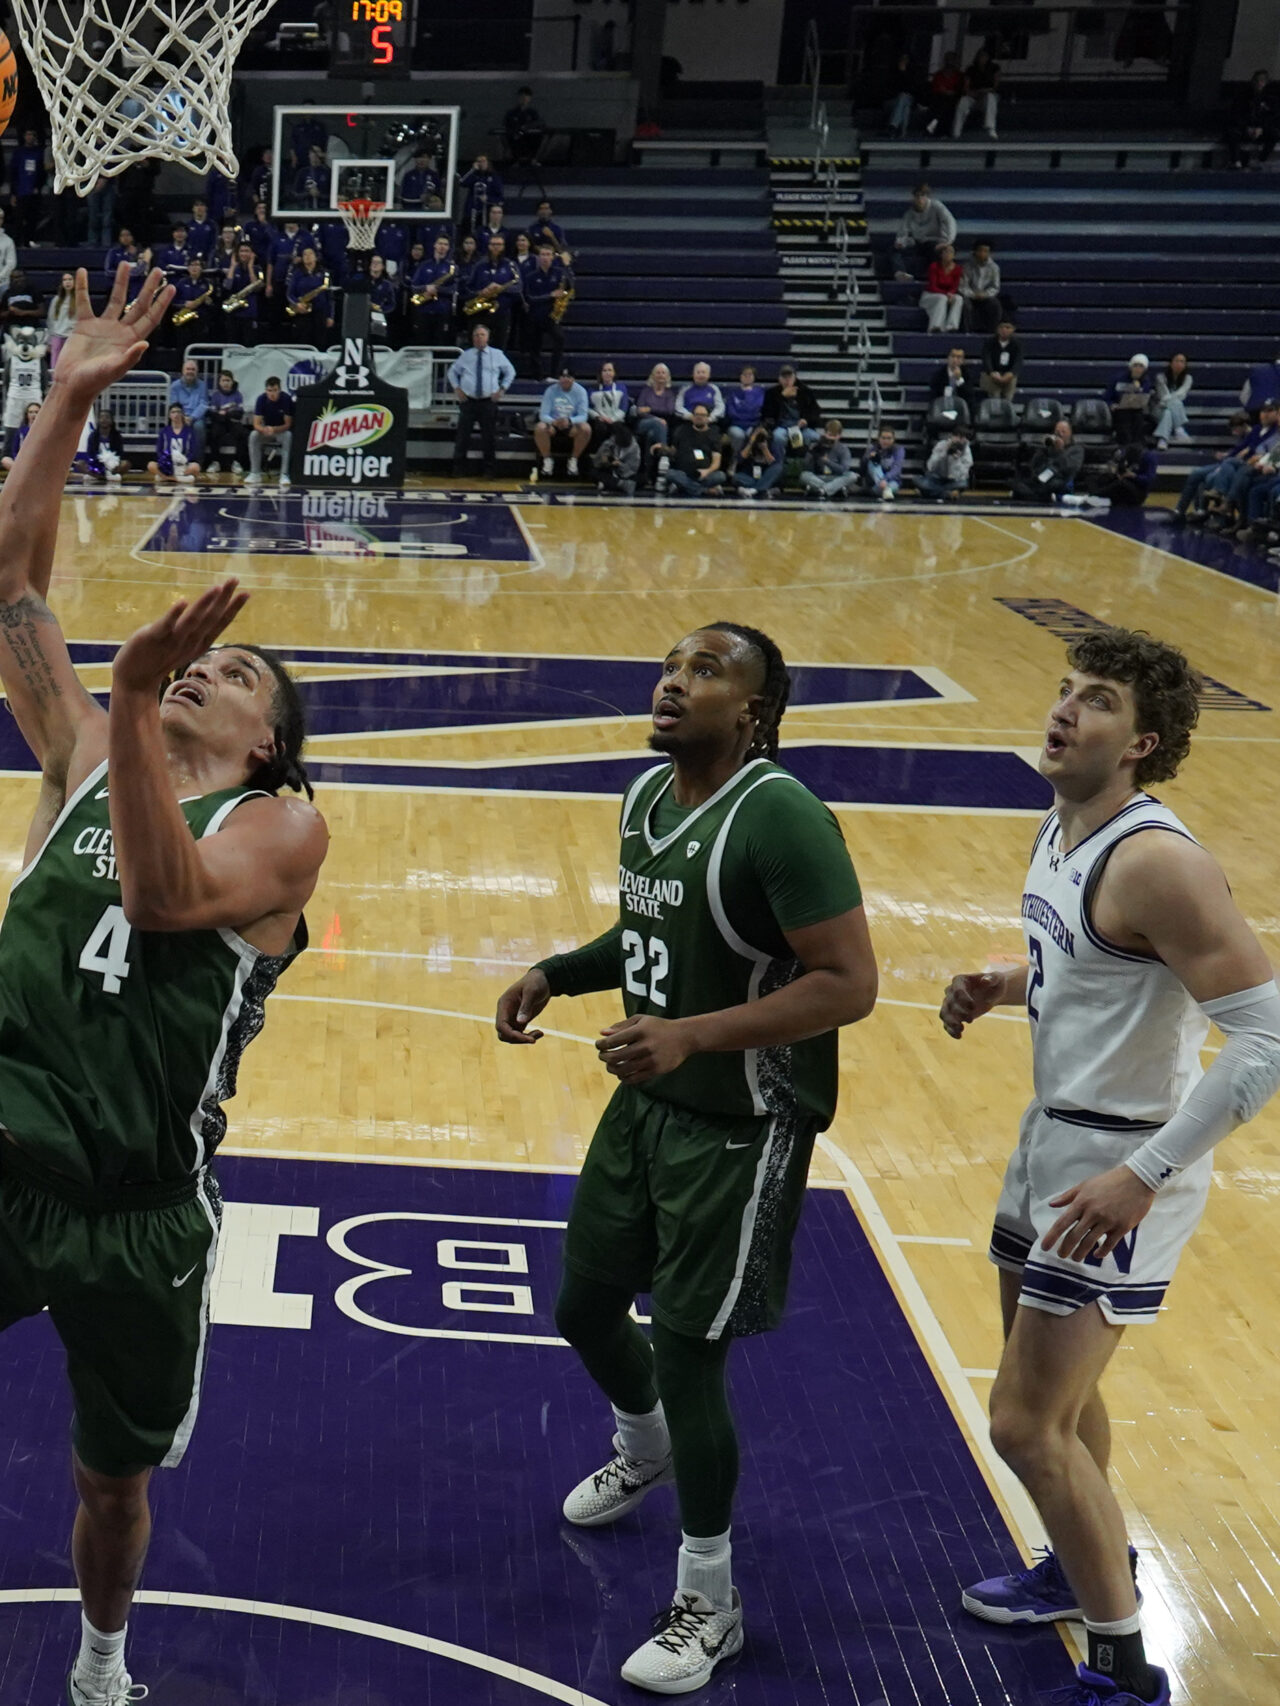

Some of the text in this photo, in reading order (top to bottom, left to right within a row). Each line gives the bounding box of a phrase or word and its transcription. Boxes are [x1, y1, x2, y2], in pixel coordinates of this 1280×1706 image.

[352, 0, 402, 22] 17:09
[372, 26, 393, 63] 5
[344, 338, 363, 365] N
[309, 412, 385, 448] LIBMAN
[303, 447, 392, 484] meijer
[625, 893, 662, 919] STATE
[78, 904, 132, 994] 4
[622, 929, 669, 1008] 22
[1027, 934, 1045, 1023] 2
